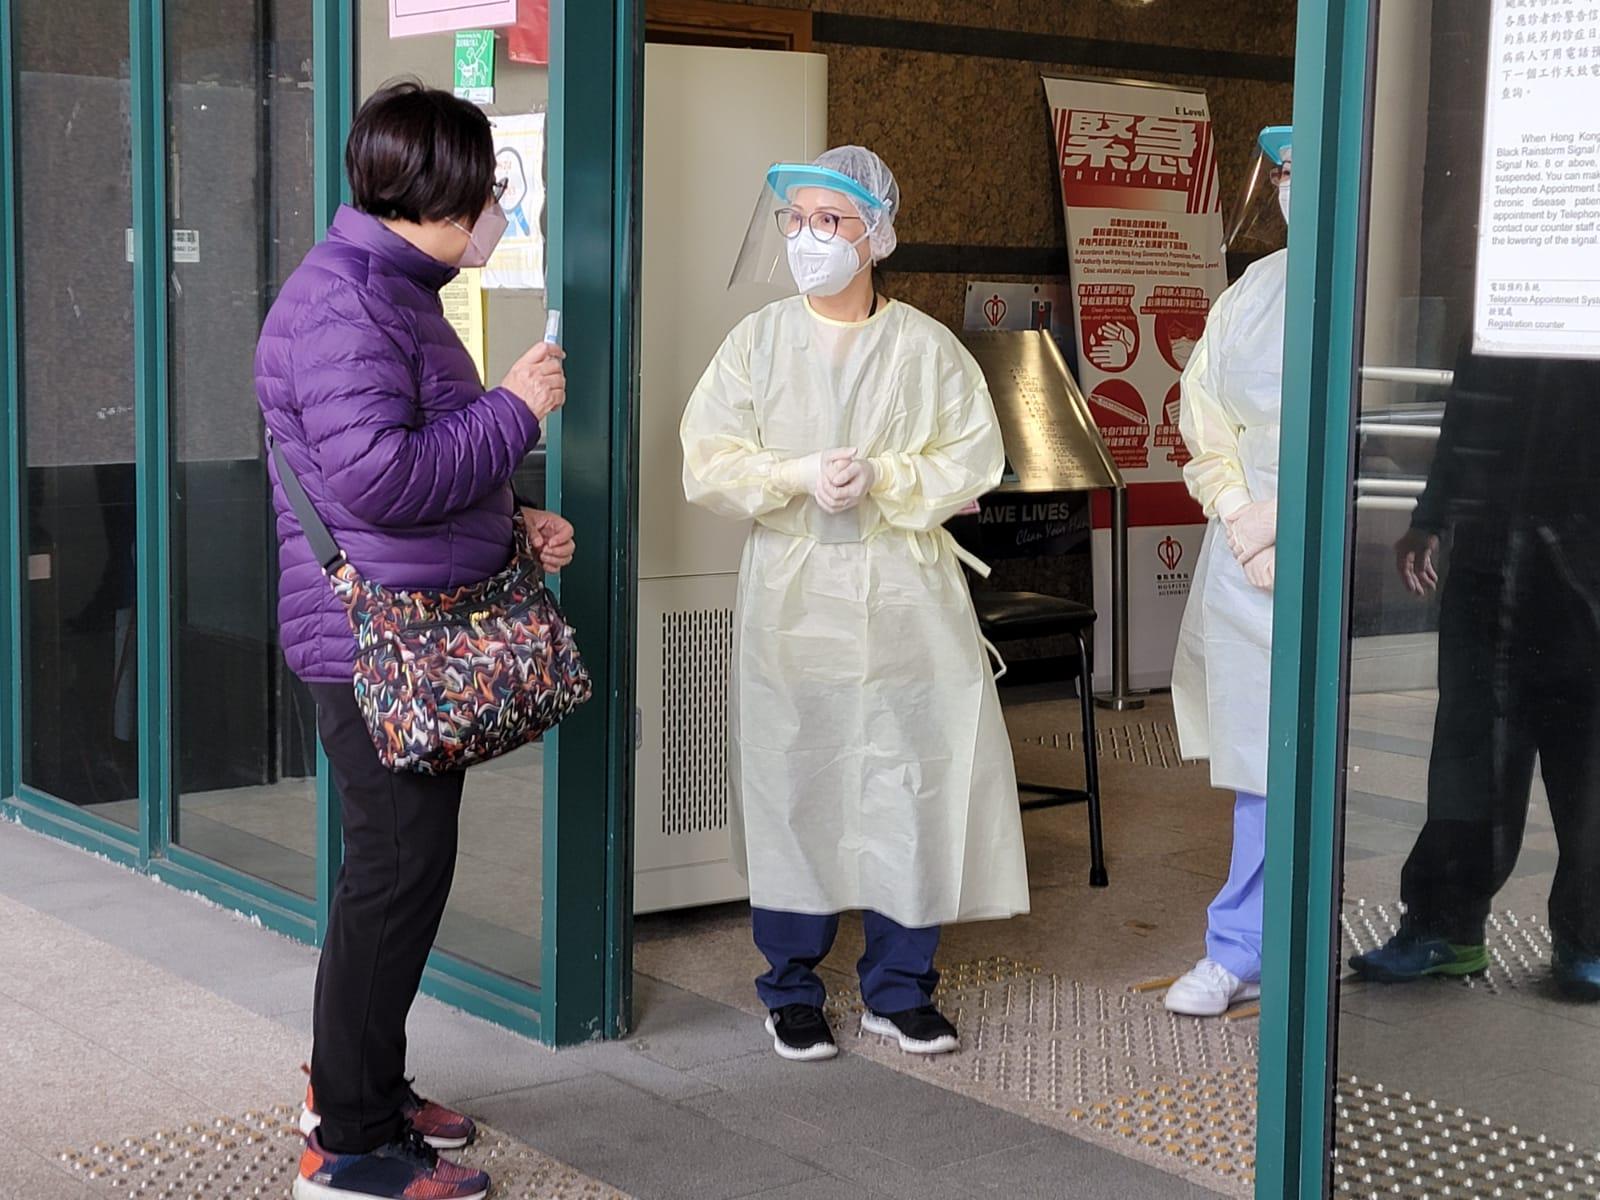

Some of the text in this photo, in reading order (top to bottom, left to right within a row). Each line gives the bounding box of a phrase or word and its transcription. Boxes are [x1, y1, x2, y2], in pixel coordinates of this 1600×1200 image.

[1183, 107, 1205, 117] Level
[1064, 112, 1197, 175] 緊急
[1521, 133, 1546, 143] When
[1550, 132, 1574, 144] Hong
[1496, 147, 1519, 157] Black
[1521, 146, 1565, 156] Rainstorm
[1567, 145, 1595, 156] Signal
[1496, 160, 1522, 171] Signal
[1545, 159, 1551, 168] 8
[1555, 160, 1564, 168] or
[1496, 172, 1543, 183] suspended.
[1546, 172, 1562, 181] You
[1564, 172, 1580, 180] can
[1496, 184, 1538, 196] Telephone
[1539, 183, 1595, 195] Appointment
[1493, 199, 1524, 208] chronic
[1532, 197, 1566, 207] disease
[1493, 208, 1600, 222] appointment by Telephon
[1492, 223, 1522, 232] contact
[1524, 224, 1538, 232] our
[1540, 223, 1573, 232] counter
[1575, 222, 1594, 231] staff
[1492, 235, 1505, 245] the
[1507, 235, 1542, 247] lowering
[1544, 235, 1553, 245] of
[1555, 235, 1569, 245] the
[1489, 294, 1528, 305] Telephone
[1529, 294, 1579, 306] Appointment
[1488, 318, 1565, 330] Registration counter
[979, 503, 1071, 524] AVE LIVES
